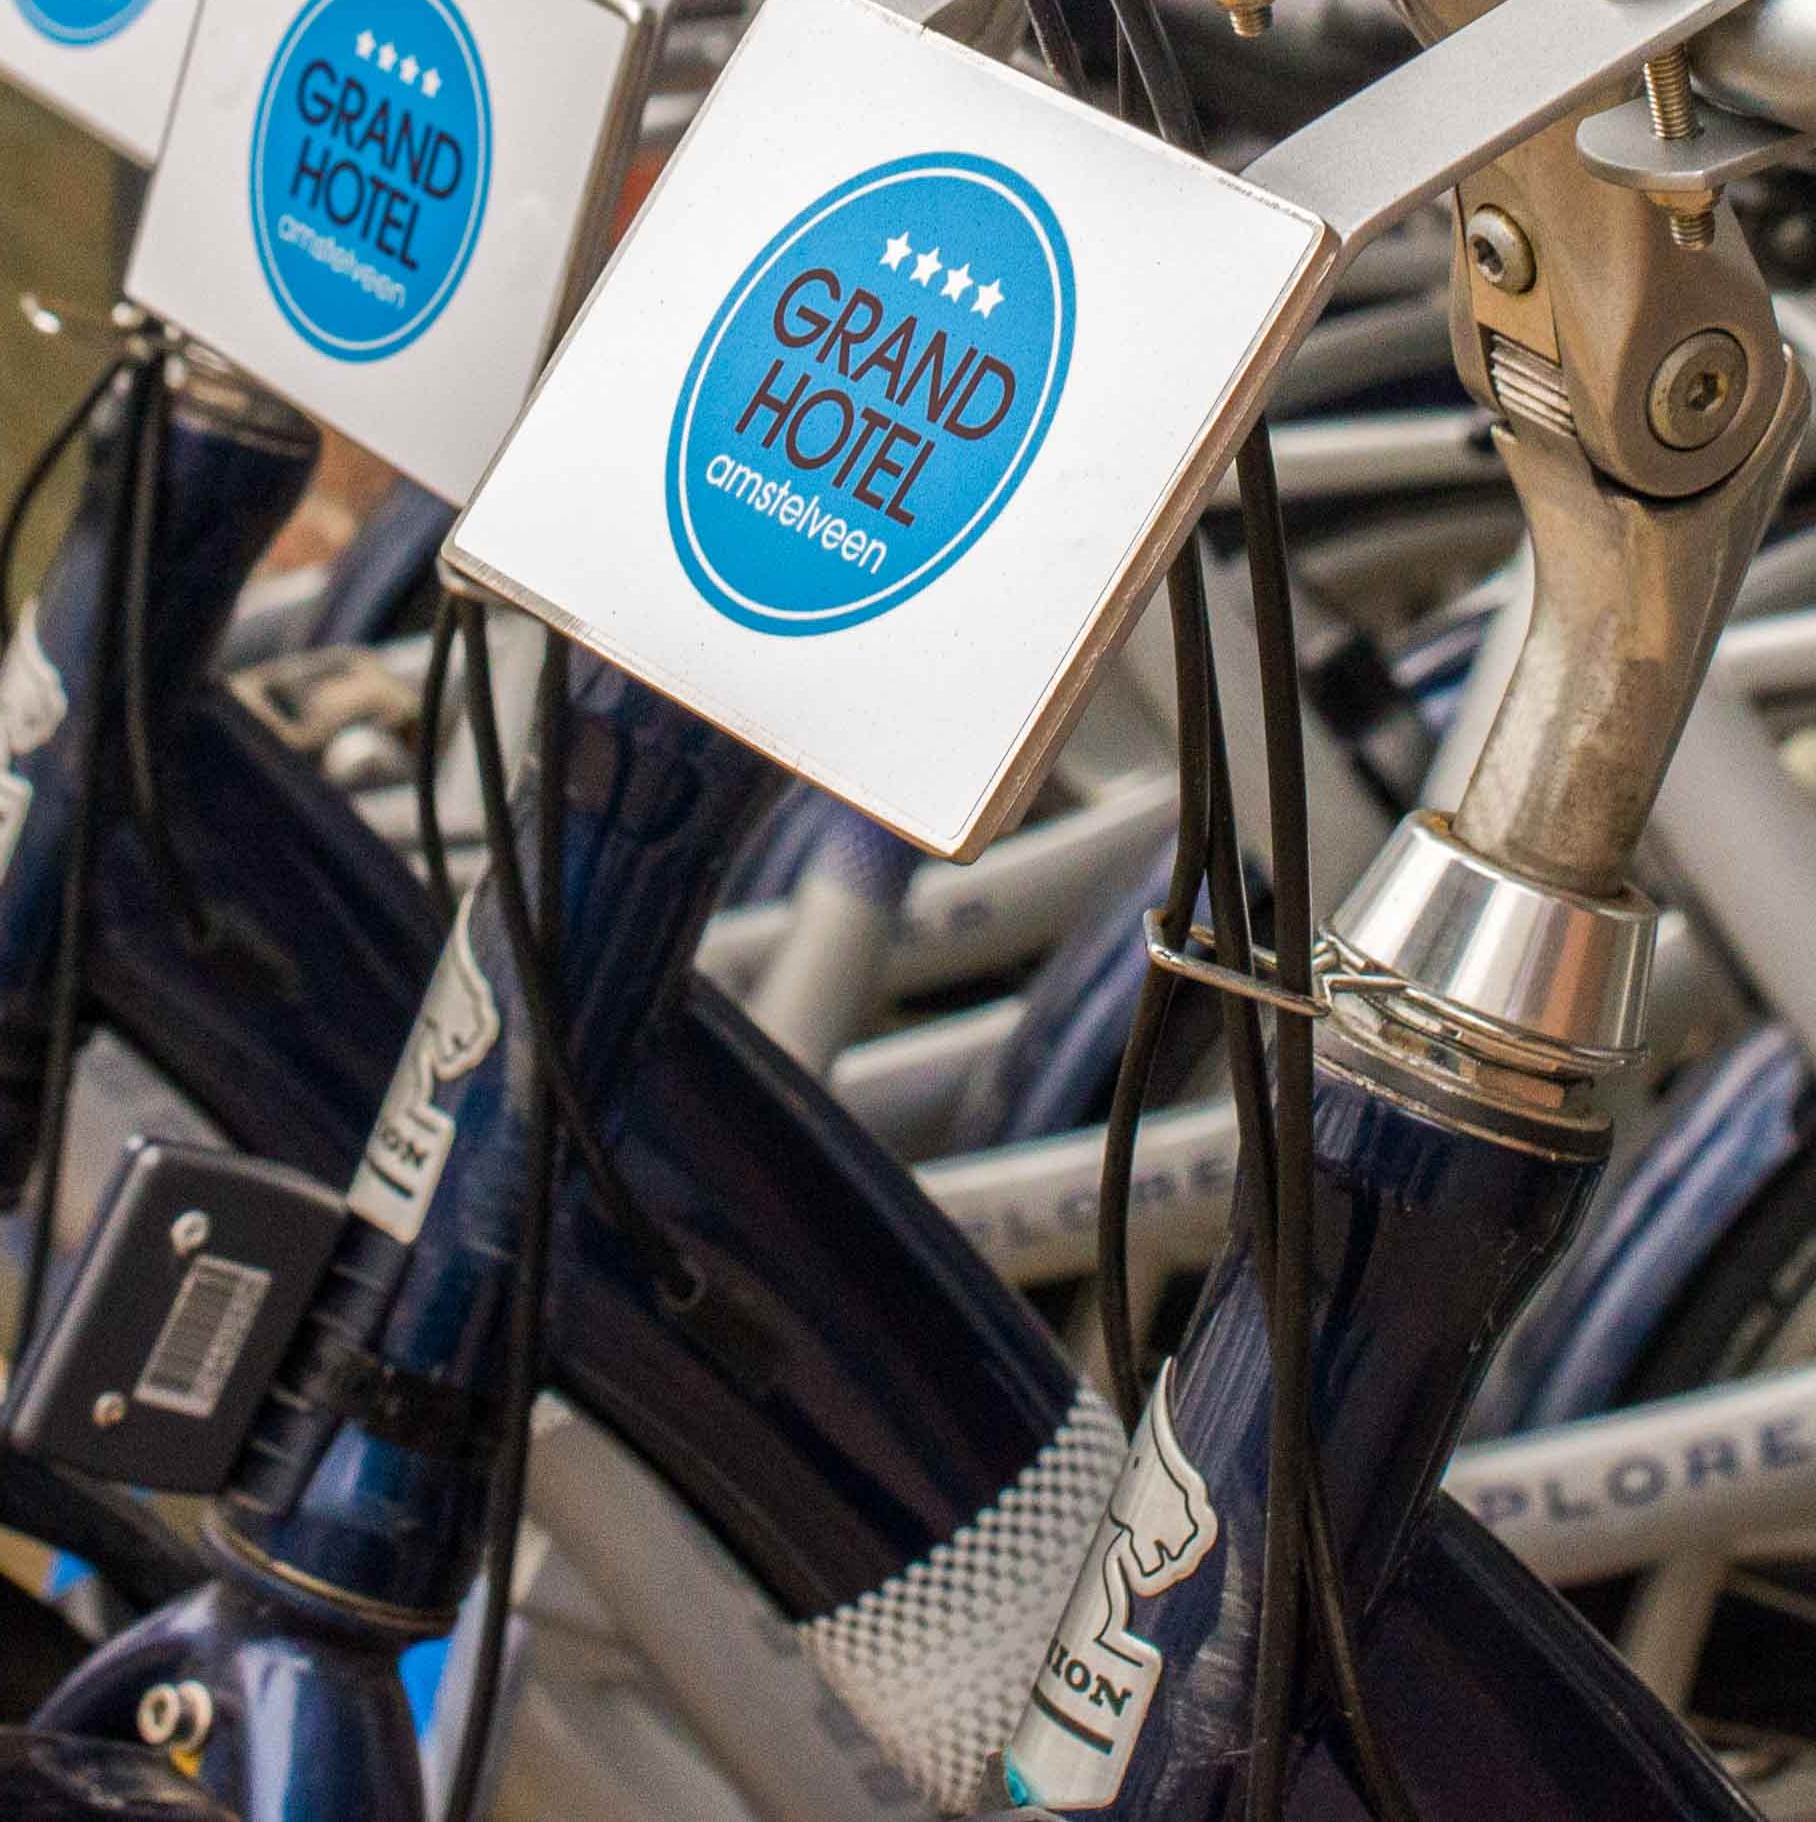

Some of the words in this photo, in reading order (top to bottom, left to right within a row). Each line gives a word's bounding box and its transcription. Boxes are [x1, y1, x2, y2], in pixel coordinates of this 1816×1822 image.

[295, 58, 464, 201] GRAND
[277, 212, 407, 310] amstelveen
[288, 134, 420, 272] HOTEL
[772, 267, 1017, 442] GRAND
[705, 449, 888, 575] amstelveen
[734, 357, 936, 528] HOTEL
